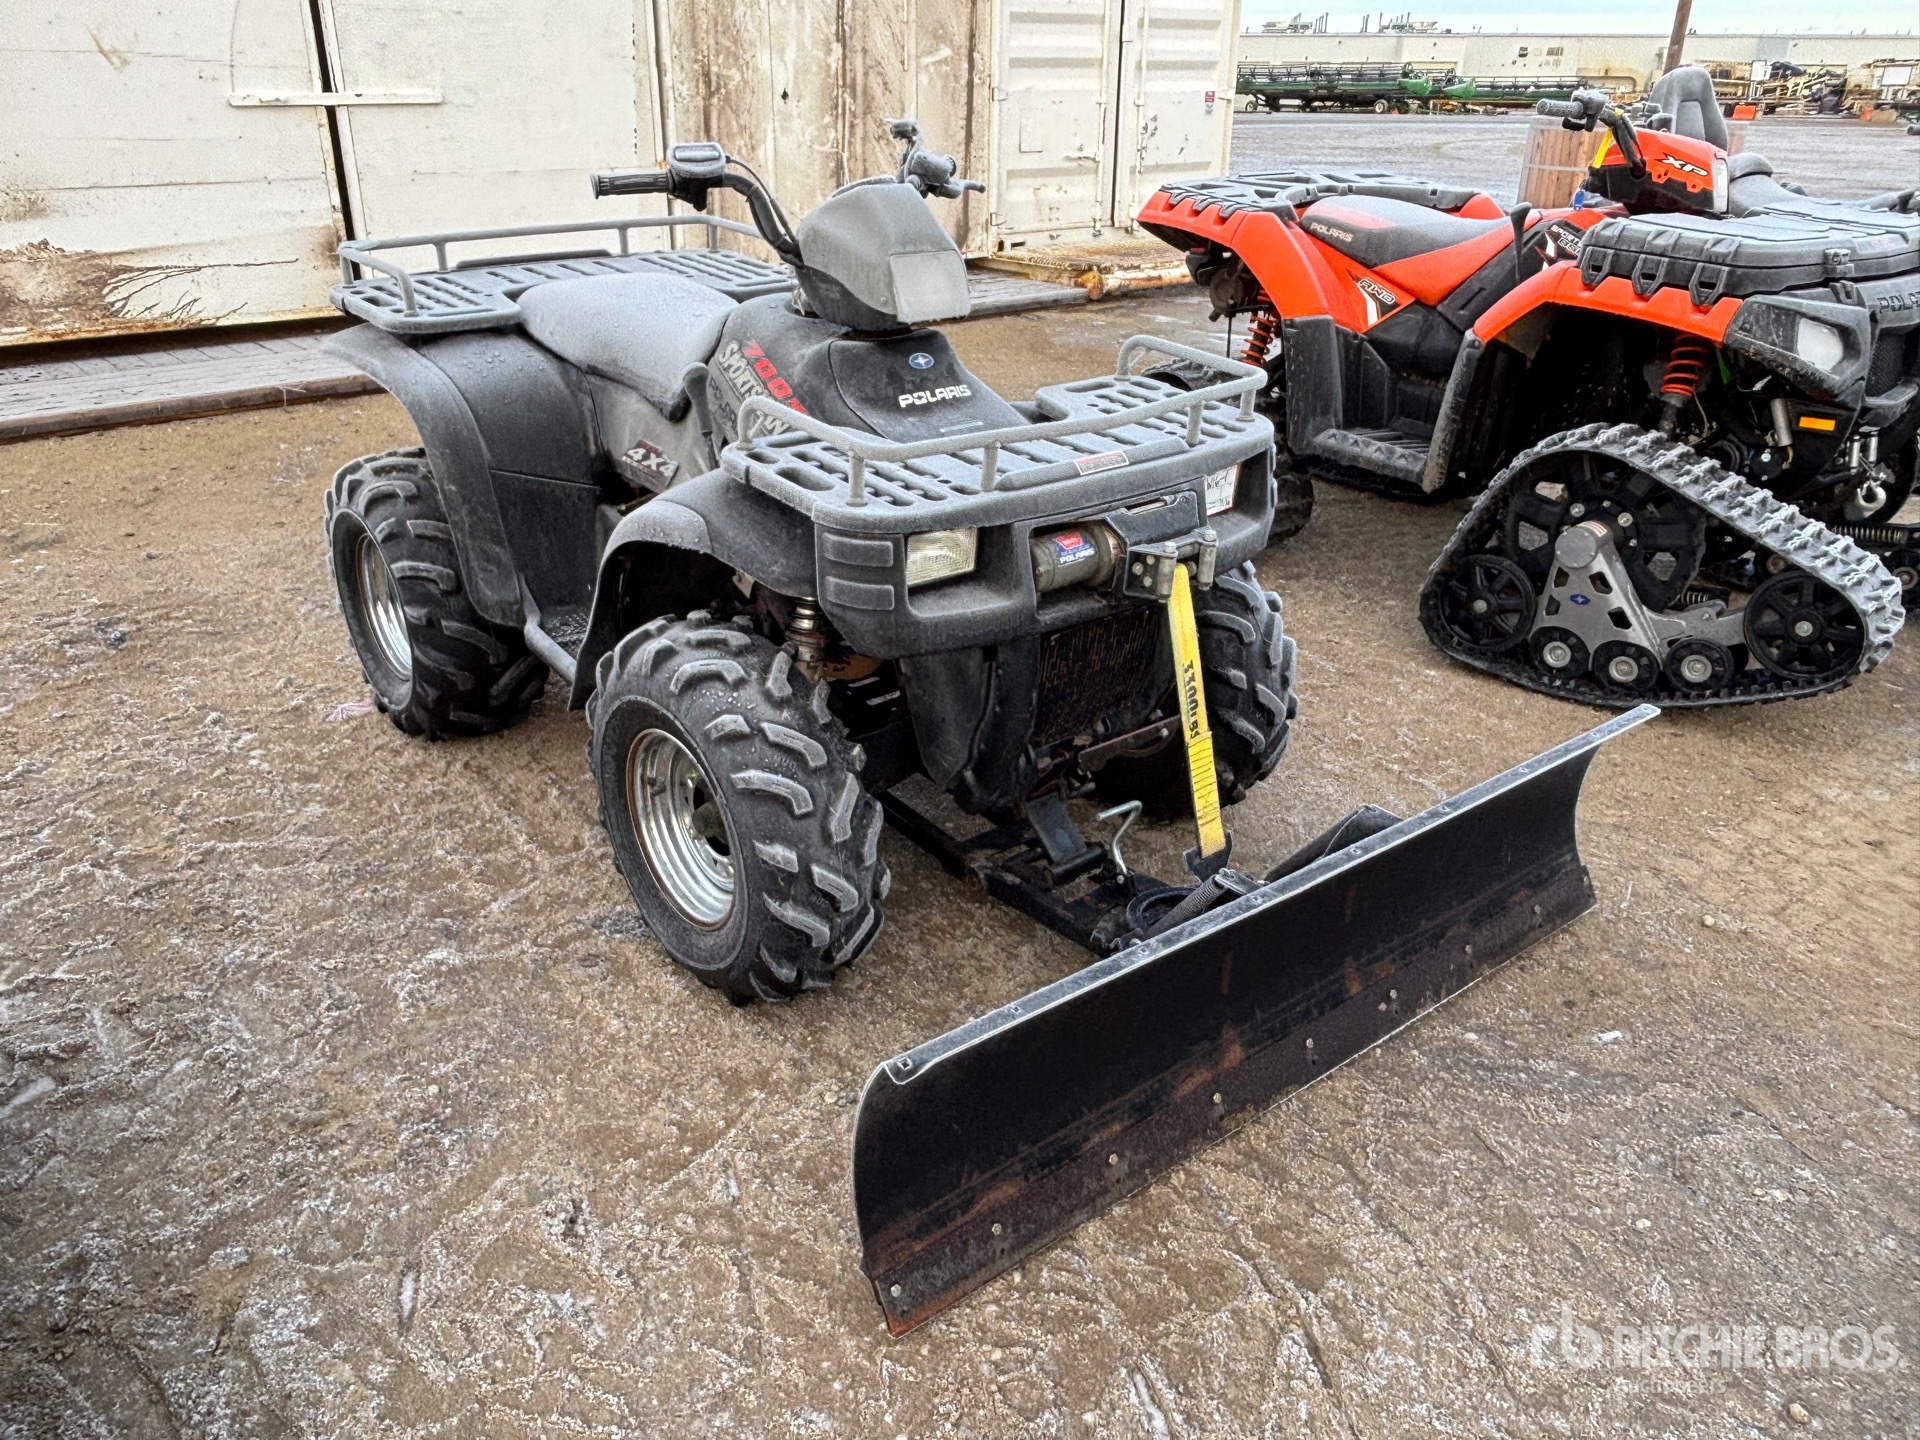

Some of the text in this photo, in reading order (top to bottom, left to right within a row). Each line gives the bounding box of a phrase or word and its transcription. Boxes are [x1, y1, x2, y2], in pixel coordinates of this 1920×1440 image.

[1658, 153, 1708, 176] XP
[1310, 221, 1353, 243] POLARIS
[1359, 277, 1396, 305] AWD
[741, 339, 794, 400] 700
[898, 384, 972, 408] POLARIS
[627, 447, 679, 477] 4X4
[1059, 547, 1096, 564] POLARIS
